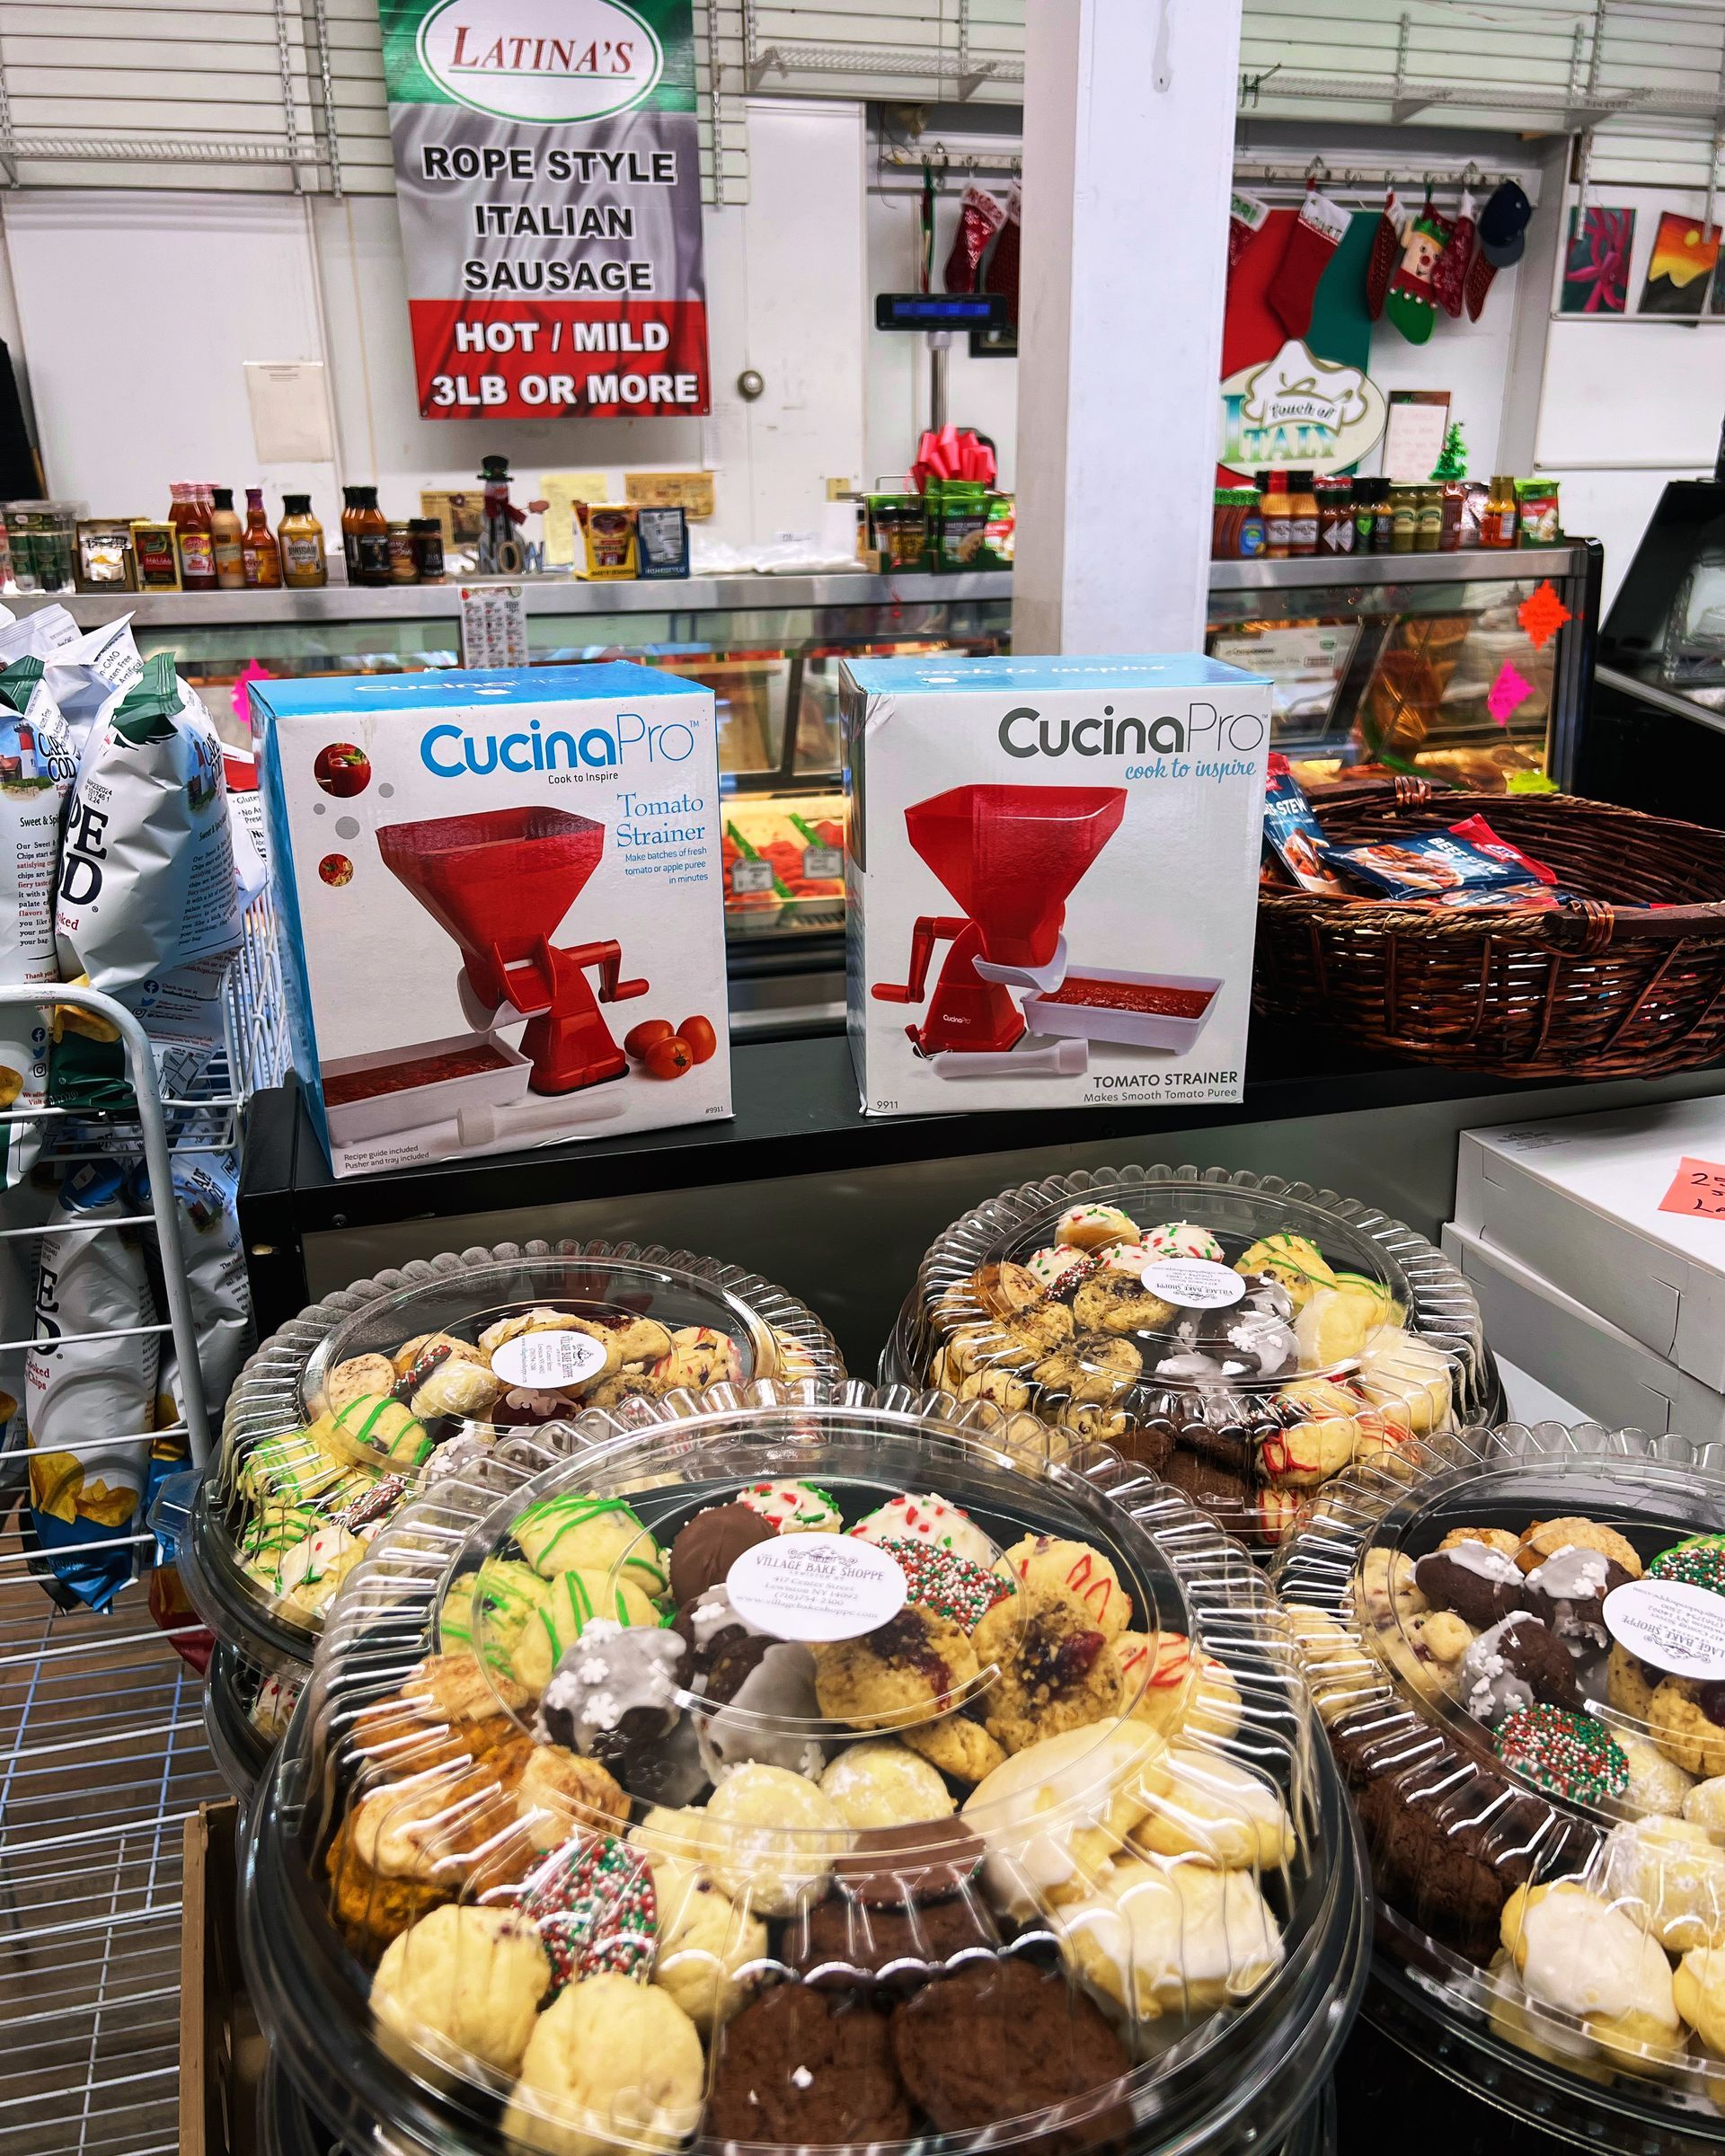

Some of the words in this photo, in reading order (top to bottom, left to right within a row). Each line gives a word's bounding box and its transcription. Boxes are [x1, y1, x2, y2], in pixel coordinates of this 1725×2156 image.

[451, 26, 634, 74] LATINA'S
[422, 146, 535, 180] ROPE
[547, 149, 677, 185] STYLE
[474, 203, 636, 240] ITALIAN
[463, 260, 656, 293] SAUSAGE
[455, 321, 539, 354] HOT
[550, 321, 562, 353] /
[573, 321, 670, 353] MILD
[431, 375, 509, 407] 3LB
[518, 375, 576, 405] OR
[587, 374, 699, 405] MORE
[998, 702, 1263, 758] CucinaPro
[38, 731, 70, 760] CAPE
[420, 713, 694, 778] CucinaPro
[48, 755, 76, 782] COD
[1125, 757, 1168, 780] cook
[1171, 756, 1191, 778] to
[1196, 759, 1257, 783] inspire
[548, 773, 572, 785] Cook
[574, 773, 584, 783] to
[586, 771, 619, 783] Inspire
[616, 792, 703, 817] Tomato
[1276, 797, 1309, 817] STEW
[242, 808, 252, 817] No
[244, 815, 262, 825] Prese
[20, 816, 42, 827] Sweet
[42, 815, 49, 826] &
[616, 822, 705, 848] Strainer
[16, 842, 31, 851] Our
[34, 840, 51, 850] Sweet
[1427, 836, 1469, 857] BEEF
[16, 852, 35, 862] Chips
[36, 850, 49, 859] start
[192, 854, 204, 864] Our
[625, 853, 646, 862] Make
[647, 850, 677, 860] batches
[679, 848, 686, 857] of
[687, 846, 707, 855] fresh
[16, 861, 46, 871] satisfying
[625, 866, 653, 876] tomato
[654, 865, 661, 873] or
[663, 862, 684, 873] apple
[685, 861, 706, 872] puree
[17, 870, 35, 880] chips
[36, 870, 46, 879] are
[669, 876, 677, 884] in
[677, 873, 708, 884] minutes
[18, 880, 34, 890] fiery
[18, 890, 23, 899] it
[26, 889, 41, 897] with
[18, 899, 41, 909] palate
[18, 909, 43, 917] flavors
[19, 919, 33, 928] you
[36, 917, 48, 926] like
[19, 929, 36, 938] your
[20, 938, 36, 948] your
[24, 971, 43, 981] Thank
[1093, 1074, 1160, 1088] TOMATO
[1164, 1071, 1238, 1085] STRAINER
[1084, 1093, 1119, 1103] Makes
[1121, 1091, 1162, 1101] Smooth
[1164, 1089, 1205, 1100] Tomato
[1208, 1088, 1237, 1098] Puree
[876, 1100, 898, 1109] 9911
[344, 1153, 367, 1162] Recipe
[369, 1149, 388, 1160] guide
[389, 1145, 419, 1155] included
[345, 1161, 369, 1169] Pusher
[385, 1157, 399, 1165] tray
[401, 1152, 429, 1162] included
[756, 1555, 802, 1571] VILLAGE
[805, 1562, 836, 1575] BAKE
[841, 1567, 885, 1582] SHOPPE
[811, 1587, 829, 1596] NY
[1622, 1614, 1663, 1635] SHOPPE
[1667, 1630, 1694, 1647] BAKE
